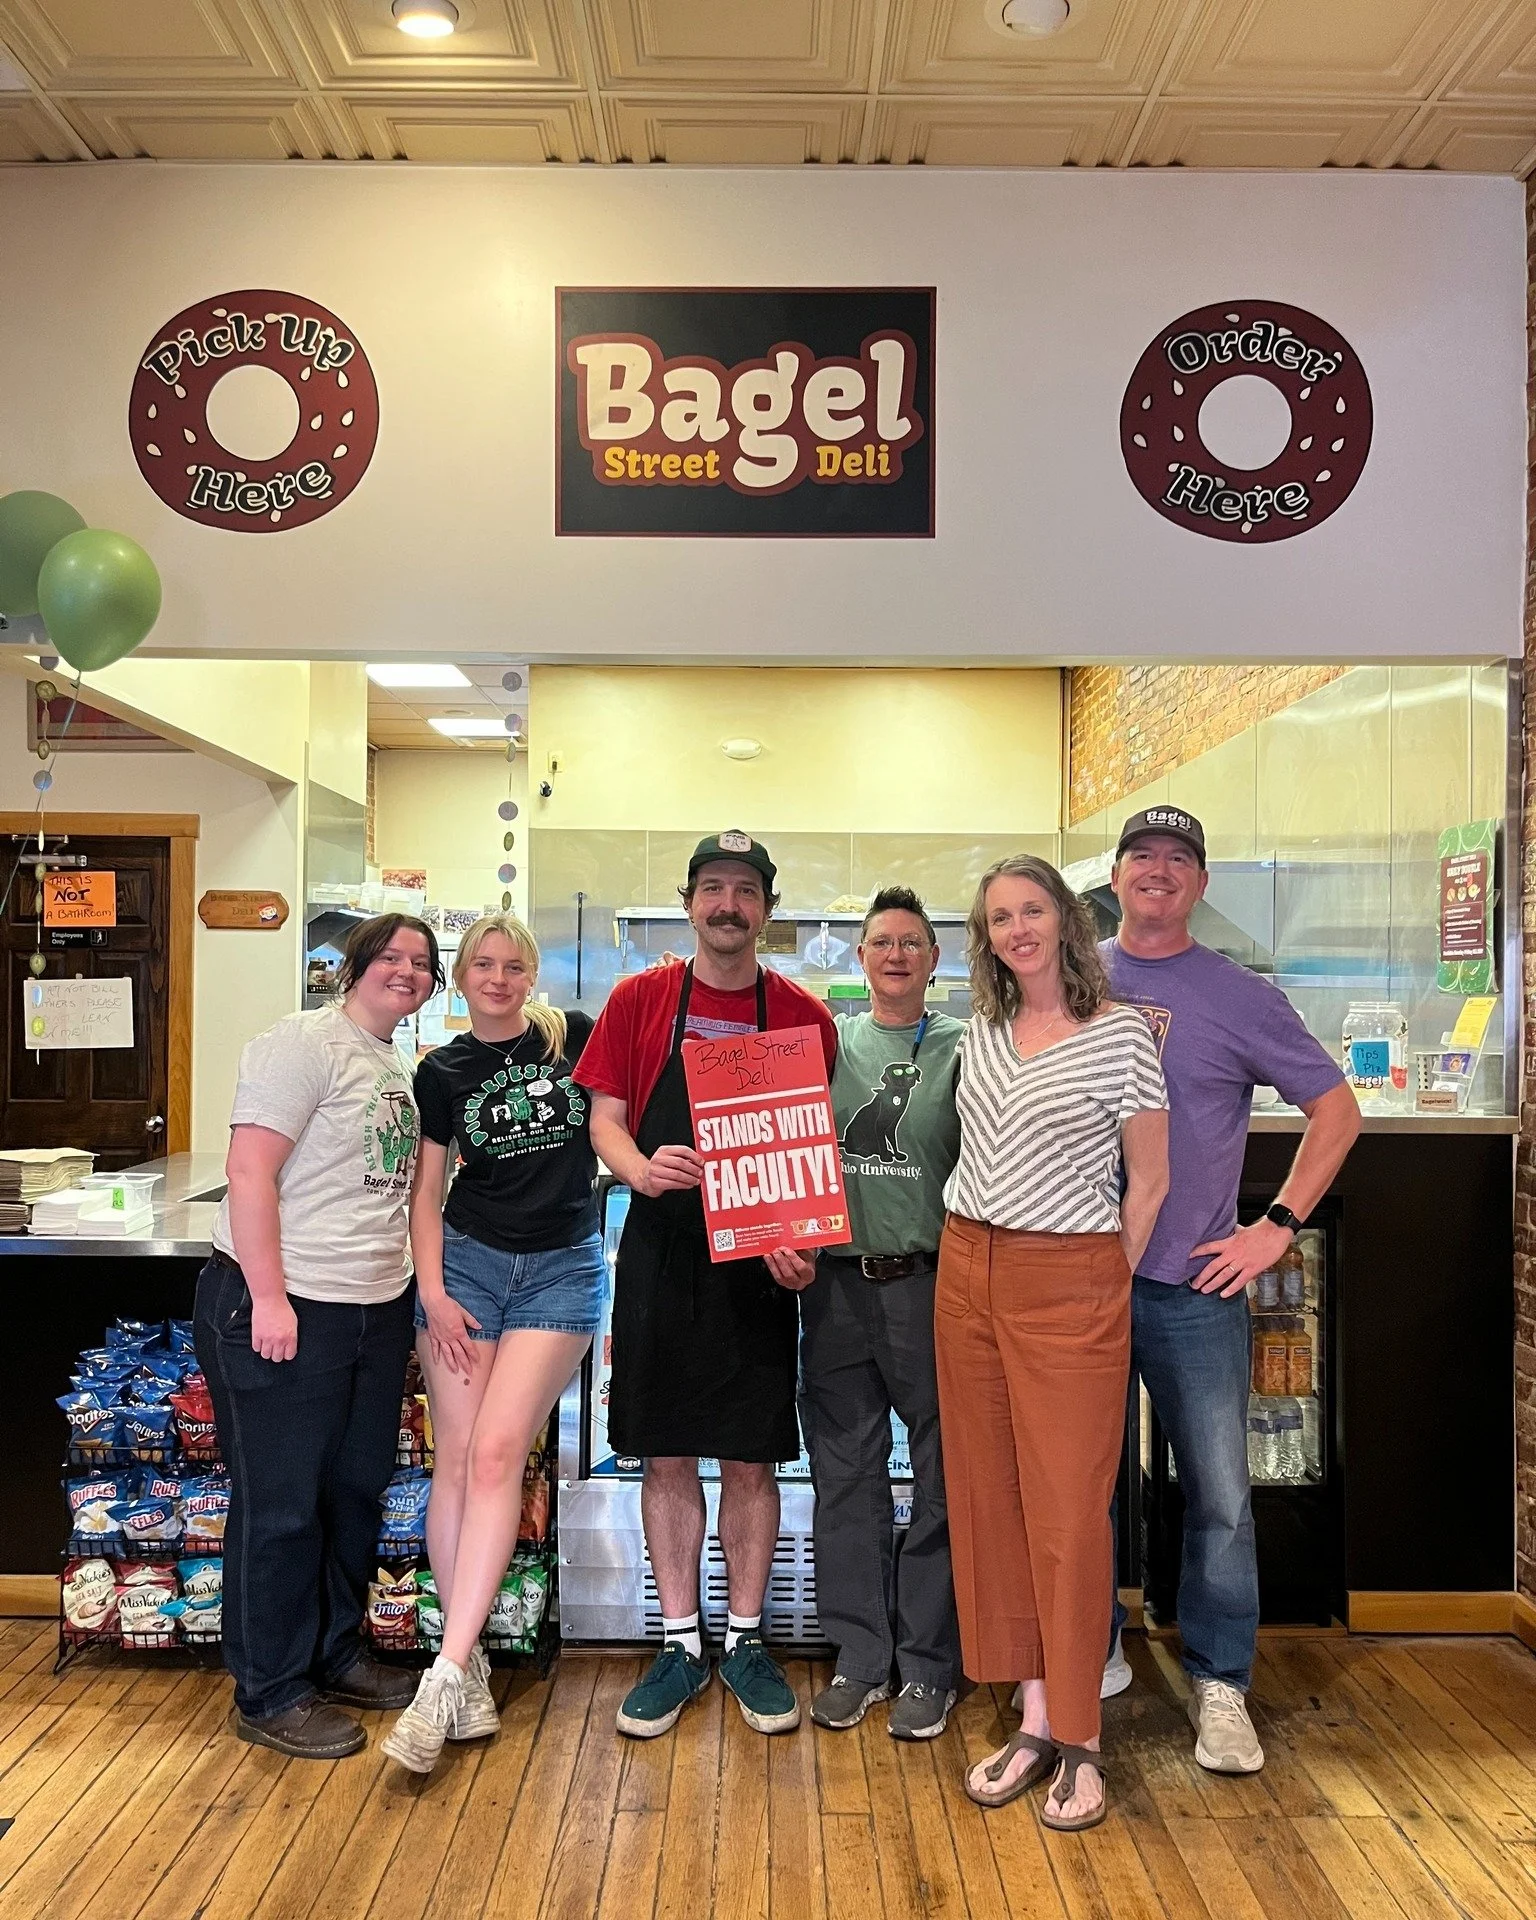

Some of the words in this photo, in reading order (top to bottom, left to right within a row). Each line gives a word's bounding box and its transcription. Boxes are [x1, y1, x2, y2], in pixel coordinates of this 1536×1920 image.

[143, 313, 266, 386] Pick
[279, 314, 356, 371] Up
[1167, 321, 1336, 382] Order
[576, 339, 912, 488] Bagel
[604, 446, 720, 479] Street
[816, 444, 891, 477] Deli
[188, 461, 332, 514] Here
[1166, 465, 1309, 522] Here
[1146, 811, 1192, 827] Bagel
[49, 876, 72, 885] THIS
[80, 876, 92, 885] IS
[54, 886, 91, 902] NOT
[46, 911, 53, 919] A
[51, 938, 66, 946] Only
[52, 931, 84, 939] Employees
[694, 1039, 749, 1075] Bagel
[750, 1034, 810, 1061] Street
[1352, 1047, 1379, 1062] Tips
[736, 1067, 775, 1091] Deli
[1353, 1075, 1384, 1089] Bagel
[365, 1094, 379, 1119] THE
[491, 1132, 527, 1144] RELISHED
[529, 1128, 545, 1136] OUR
[547, 1124, 565, 1132] TIME
[697, 1109, 775, 1153] STANDS
[774, 1101, 831, 1143] WITH
[363, 1125, 377, 1173] RELISH
[485, 1140, 517, 1155] Bagel
[517, 1134, 552, 1148] Street
[552, 1129, 574, 1141] Deli
[840, 1161, 858, 1174] hio
[363, 1174, 392, 1188] Bagel
[703, 1143, 840, 1212] FACULTY!
[67, 1409, 115, 1425] Doritos
[616, 1458, 641, 1468] Bagel
[70, 1482, 117, 1509] RUFFLES
[151, 1481, 181, 1497] RUFF
[387, 1497, 415, 1508] Sun
[131, 1509, 166, 1529] FFLES
[203, 1578, 223, 1593] Vick
[523, 1588, 540, 1601] kie's
[374, 1602, 411, 1616] Fritos
